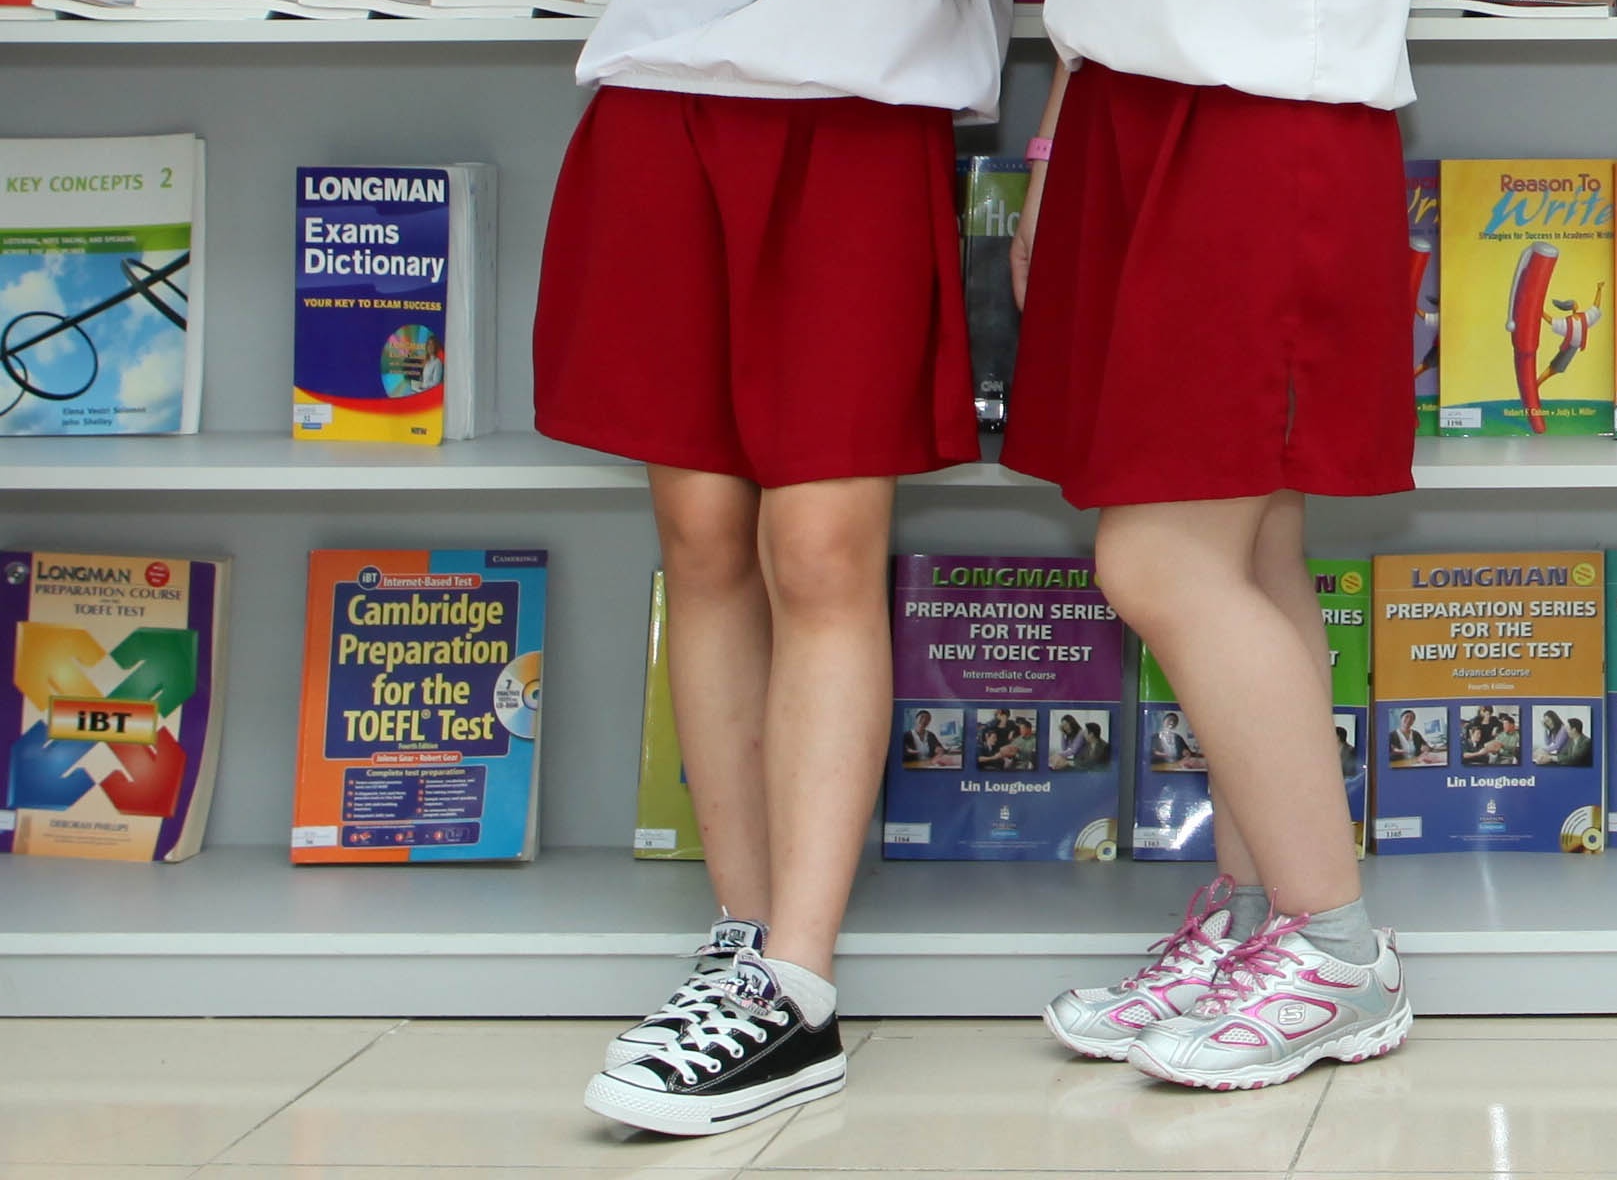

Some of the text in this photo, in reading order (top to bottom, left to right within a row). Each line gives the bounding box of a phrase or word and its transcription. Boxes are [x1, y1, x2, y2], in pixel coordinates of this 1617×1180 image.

[7, 168, 174, 193] KEY CONCEPTS 2
[304, 177, 445, 203] LONGMAN
[1500, 174, 1601, 192] Reason To
[304, 217, 399, 245] Exams
[304, 249, 445, 282] Dictionary
[304, 298, 441, 311] YOUR KEY TO EXAM SUCCESS
[37, 561, 131, 583] LONGMAN
[362, 571, 473, 588] iBT Internet-Based Test
[932, 567, 1089, 589] LONGMAN
[1411, 566, 1568, 588] LONGMAN
[35, 585, 183, 601] PREPARATION COURSE
[74, 603, 146, 617] TOEFL TEST
[347, 594, 504, 633] Cambridge
[905, 602, 1044, 619] PREPARATION
[1385, 600, 1597, 619] PREPARATION SERIES
[970, 624, 1052, 639] FOR THE
[338, 633, 509, 673] Preparation
[928, 645, 1092, 662] NEW TEST
[372, 673, 470, 706] for the
[77, 711, 132, 733] iBT
[438, 711, 495, 741] Test
[961, 781, 1051, 794] Lin Lougheed
